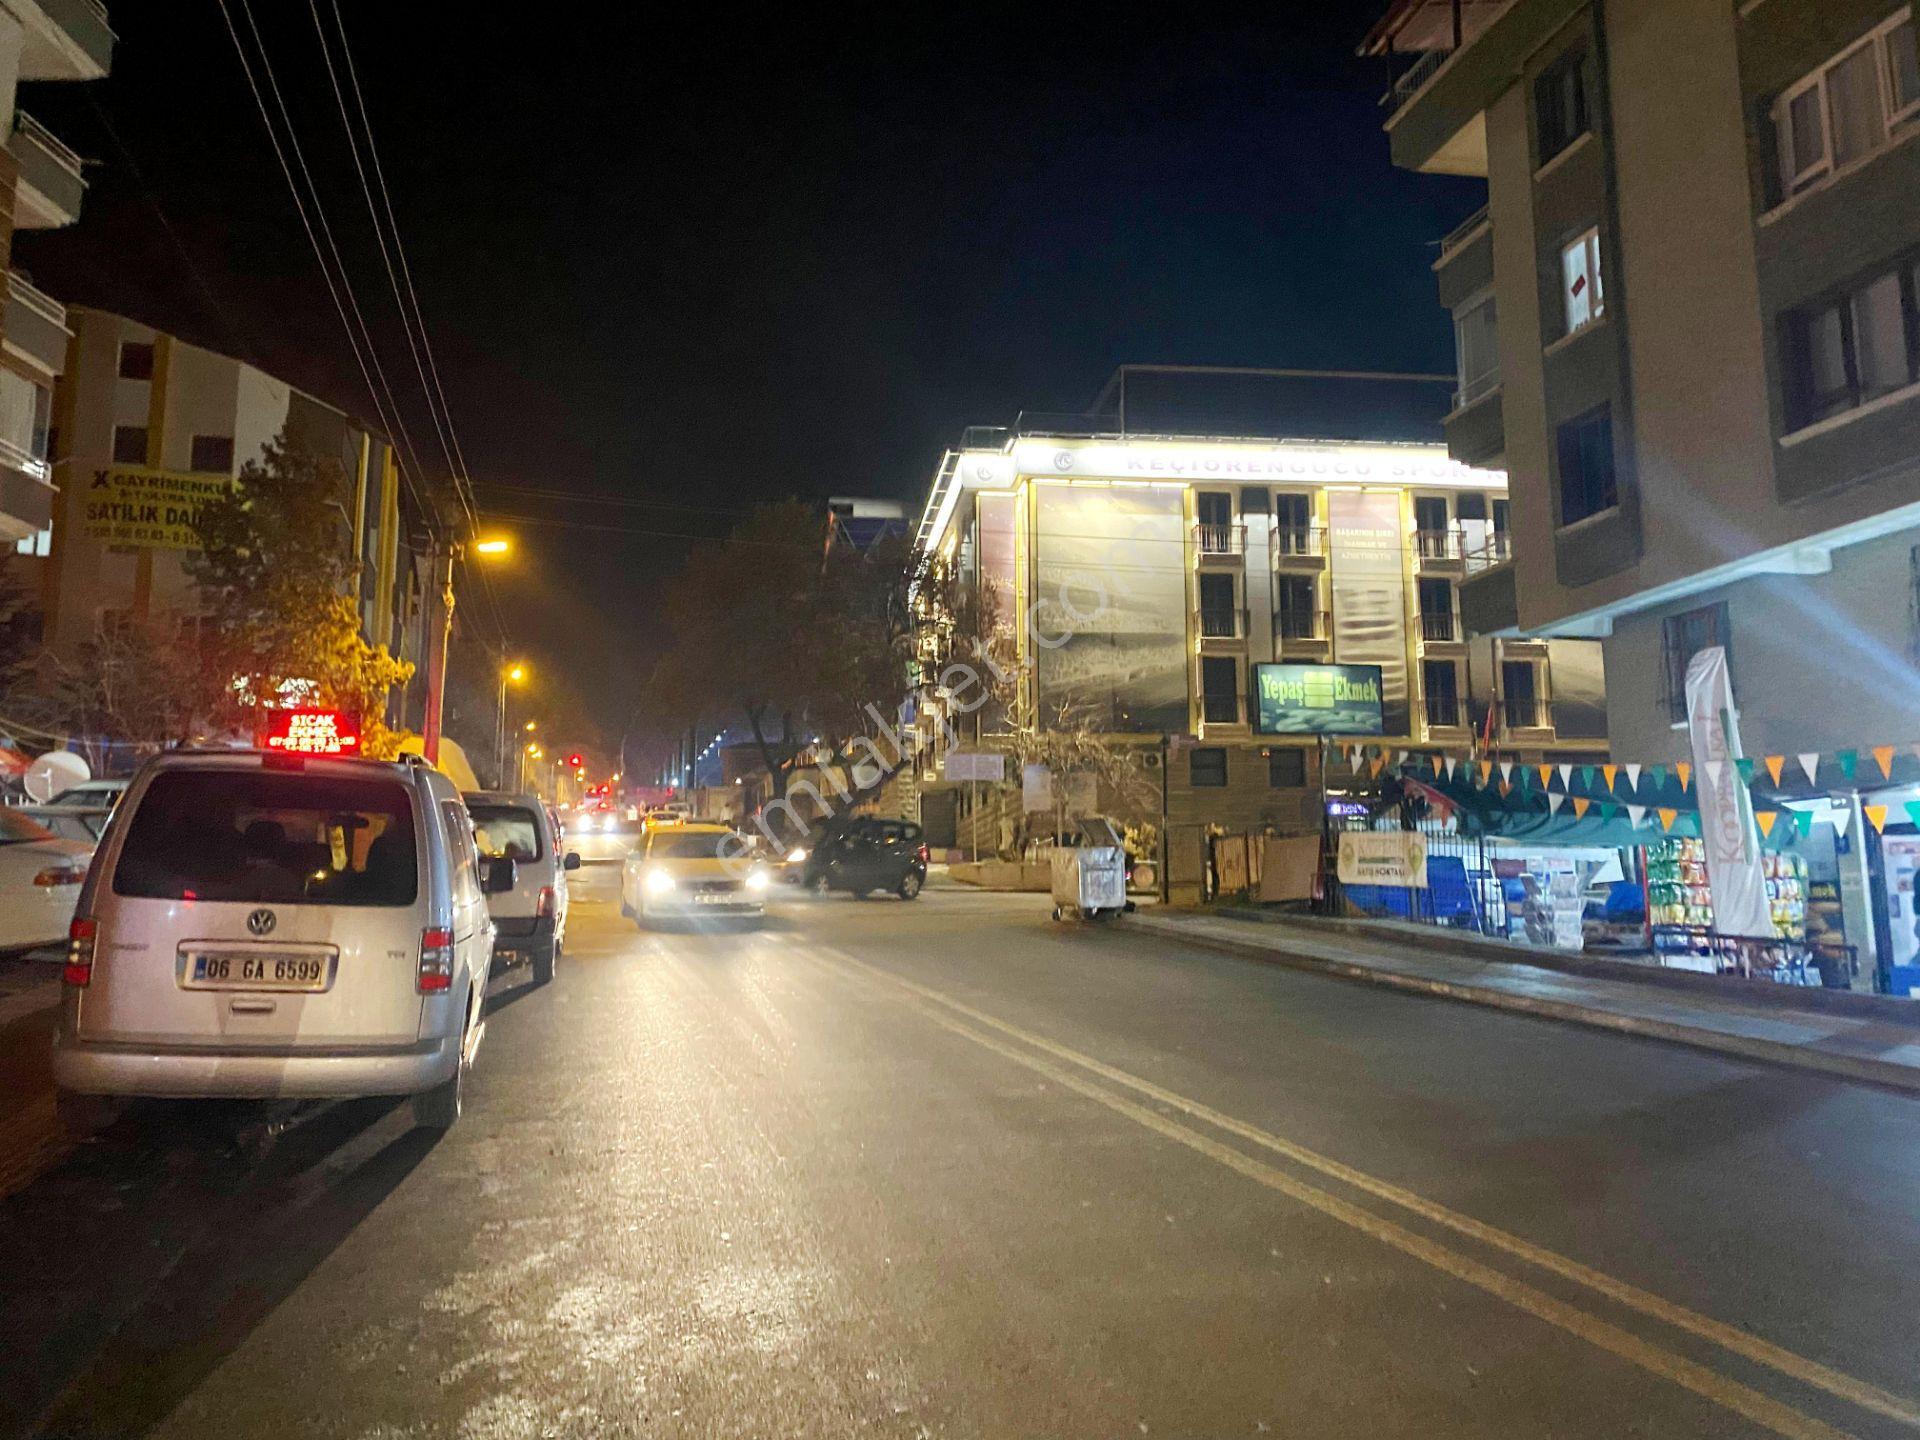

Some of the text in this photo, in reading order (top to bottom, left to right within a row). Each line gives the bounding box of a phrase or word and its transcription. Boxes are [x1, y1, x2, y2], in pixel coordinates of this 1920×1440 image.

[1261, 673, 1379, 705] Yepaş Ekmek
[290, 714, 335, 726] SICAK
[289, 726, 337, 738] EKMEK
[207, 960, 320, 980] 06 GA 6599
